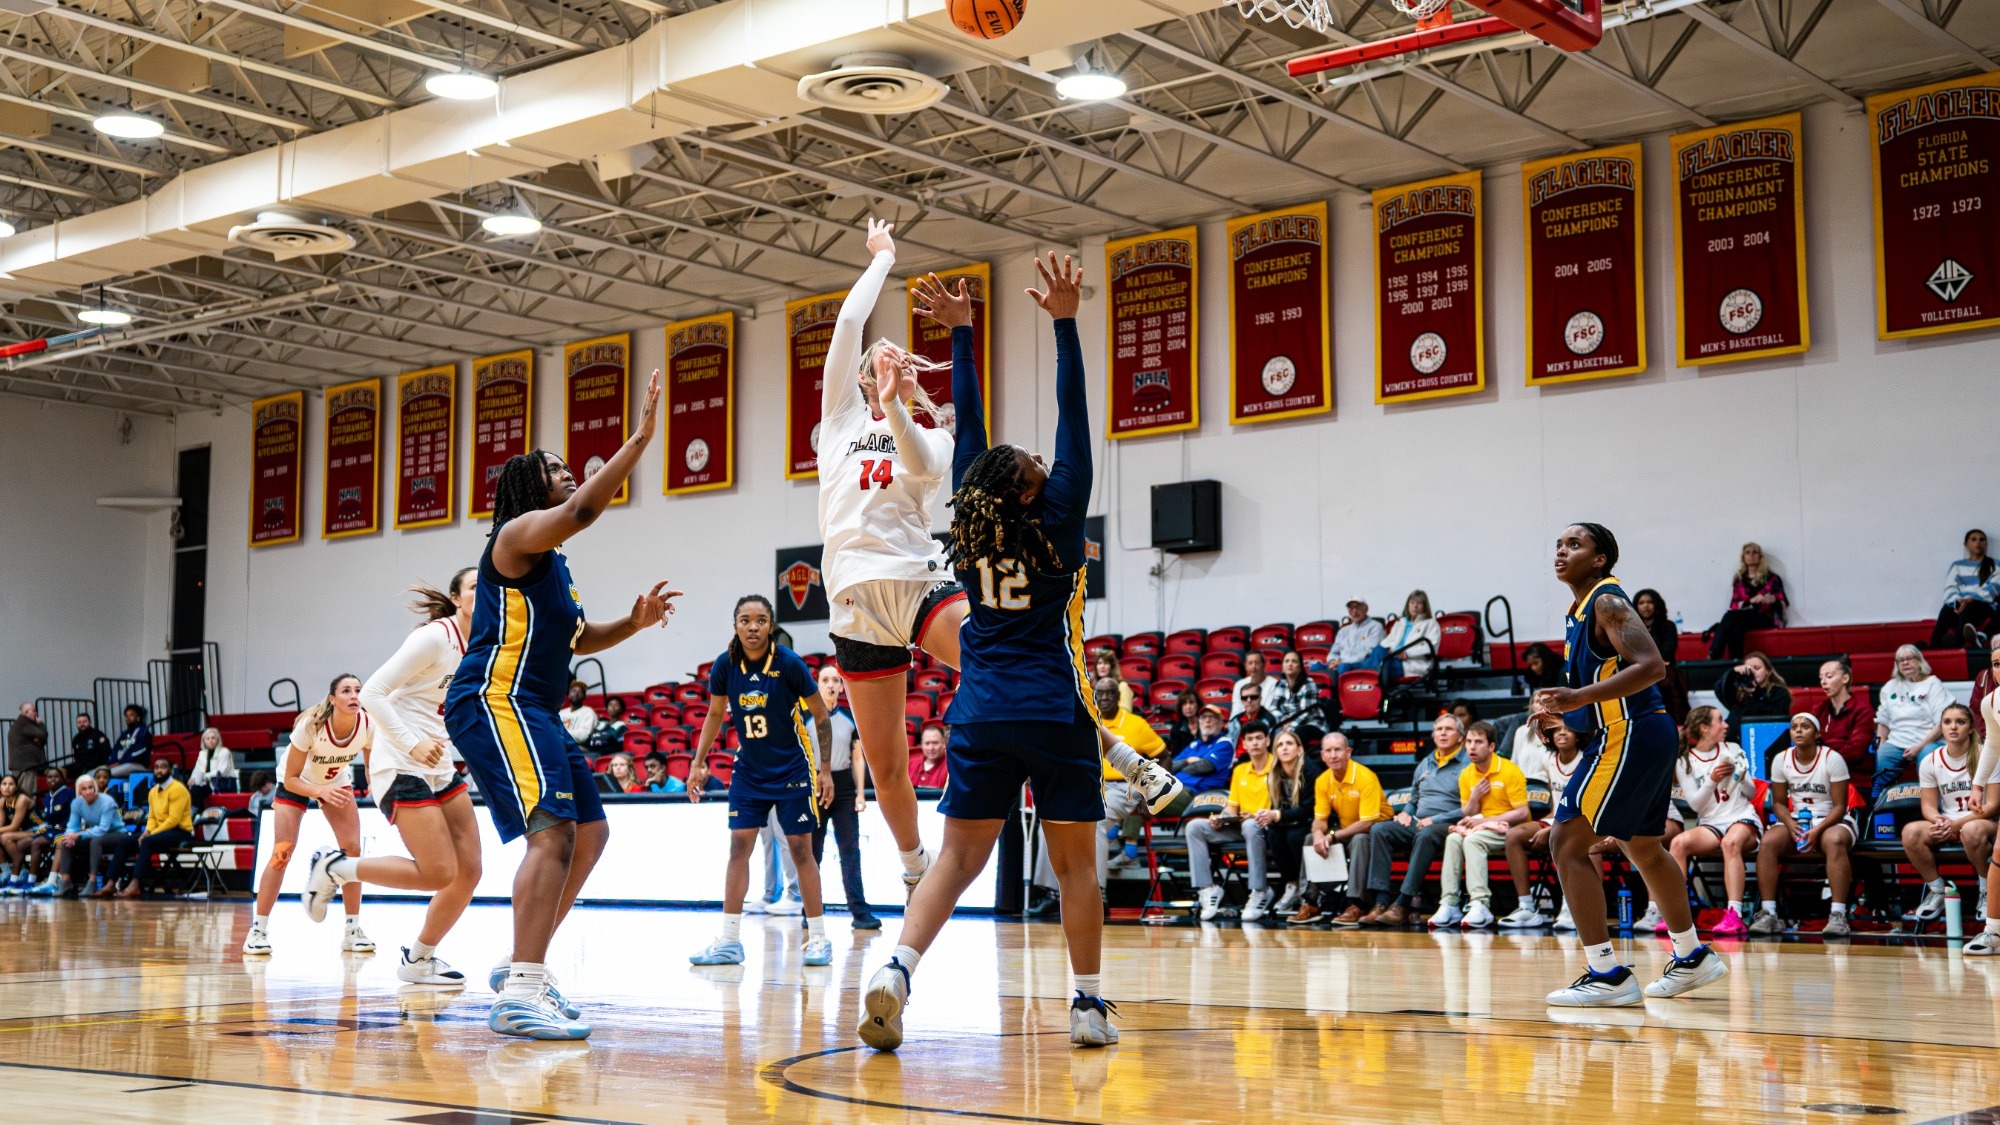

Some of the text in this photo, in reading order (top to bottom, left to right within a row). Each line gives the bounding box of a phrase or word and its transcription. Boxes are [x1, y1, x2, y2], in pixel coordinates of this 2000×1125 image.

[1918, 130, 1968, 149] FLORIDA
[1679, 129, 1794, 181] FLAGLER
[1918, 144, 1969, 167] STATE
[1529, 157, 1635, 208] FLAGLER
[1692, 163, 1781, 189] CONFERENCE
[1900, 159, 1989, 188] CHAMPIONS
[1689, 179, 1785, 206] TOURNAMENT
[1379, 185, 1475, 233] FLAGLER
[1541, 198, 1623, 223] CONFERENCE
[1698, 198, 1777, 222] CHAMPIONS
[1913, 196, 1982, 221] 1972 1973
[1232, 214, 1321, 261] FLAGLER
[1390, 224, 1464, 249] CONFERENCE
[1546, 215, 1619, 239] CHAMPIONS
[1394, 240, 1460, 264] CHAMPIONS
[1708, 231, 1771, 253] 2003 2004
[1111, 239, 1192, 282] FLAGLER
[1244, 252, 1312, 276] CONFERENCE
[1555, 257, 1612, 278] 2004 2005
[1126, 269, 1176, 288] NATIONAL
[1247, 268, 1308, 290] CHAMPIONS
[1387, 265, 1468, 289] 1992 1994 1995
[1116, 282, 1187, 304] CHAMPIONSHIP
[1416, 284, 1438, 299] 1997
[1446, 279, 1469, 294] 1999
[1117, 296, 1186, 318] APPEARANCES
[1255, 306, 1302, 325] 1992 1993
[1401, 296, 1453, 315] 2000 2001
[1729, 303, 1753, 322] FSC
[1920, 305, 1982, 323] VOLLEYBALL
[669, 323, 728, 359] FLAGLER
[1573, 325, 1596, 342] FSC
[1700, 334, 1784, 354] MEN'S BASKETBALL
[568, 343, 625, 377] FLAGLER
[676, 353, 722, 372] CONFERENCE
[1419, 345, 1439, 362] FSC
[1546, 355, 1623, 373] MEN'S BASKETBALL
[476, 358, 528, 391] FLAGLER
[574, 373, 618, 390] CONFERENCE
[678, 366, 719, 384] CHAMPIONS
[1133, 368, 1170, 395] NAIA
[1270, 368, 1289, 385] FSC
[1384, 372, 1474, 393] WOMEN'S CROSS COUNTRY
[479, 394, 523, 410] TOURNAMENT
[485, 384, 517, 398] NATIONAL
[575, 386, 615, 402] CHAMPIONS
[479, 405, 523, 421] APPEARANCES
[1243, 395, 1316, 414] MEN'S CROSS COUNTRY
[1119, 411, 1185, 428] MEN'S CROSS COUNTRY
[860, 458, 894, 490] 14
[976, 557, 1031, 610] 12
[739, 692, 768, 708] GSW
[744, 714, 768, 739] 13
[324, 766, 340, 780] 5
